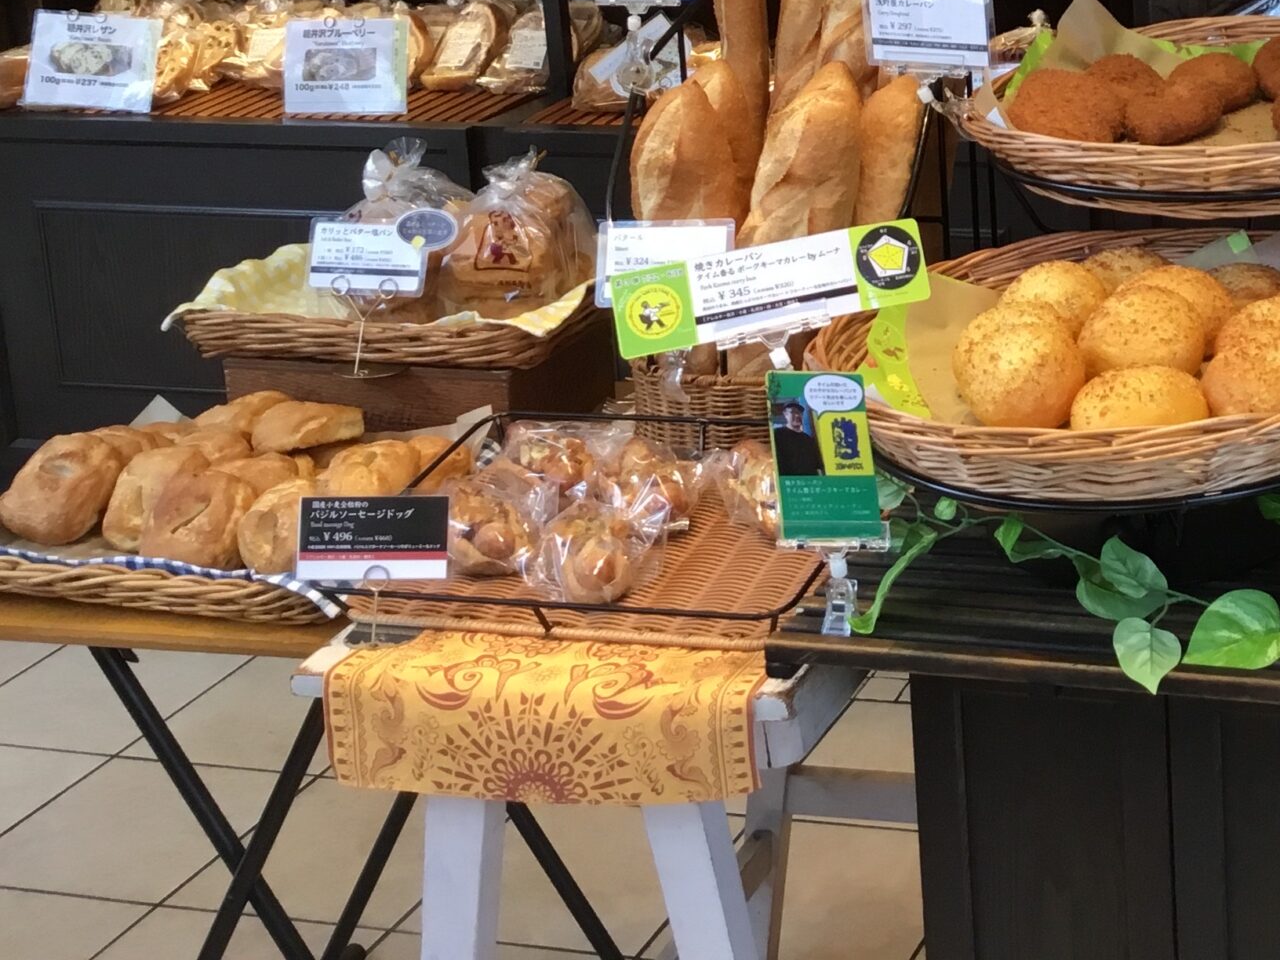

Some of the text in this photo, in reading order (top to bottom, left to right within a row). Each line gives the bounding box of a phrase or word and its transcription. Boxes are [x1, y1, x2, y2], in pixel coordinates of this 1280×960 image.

[613, 233, 644, 242] バタール
[694, 251, 763, 273] 焼きカレーパン
[718, 286, 752, 301] ¥345
[309, 507, 416, 520] バジルソーセージドッグ
[323, 531, 353, 542] ¥496
